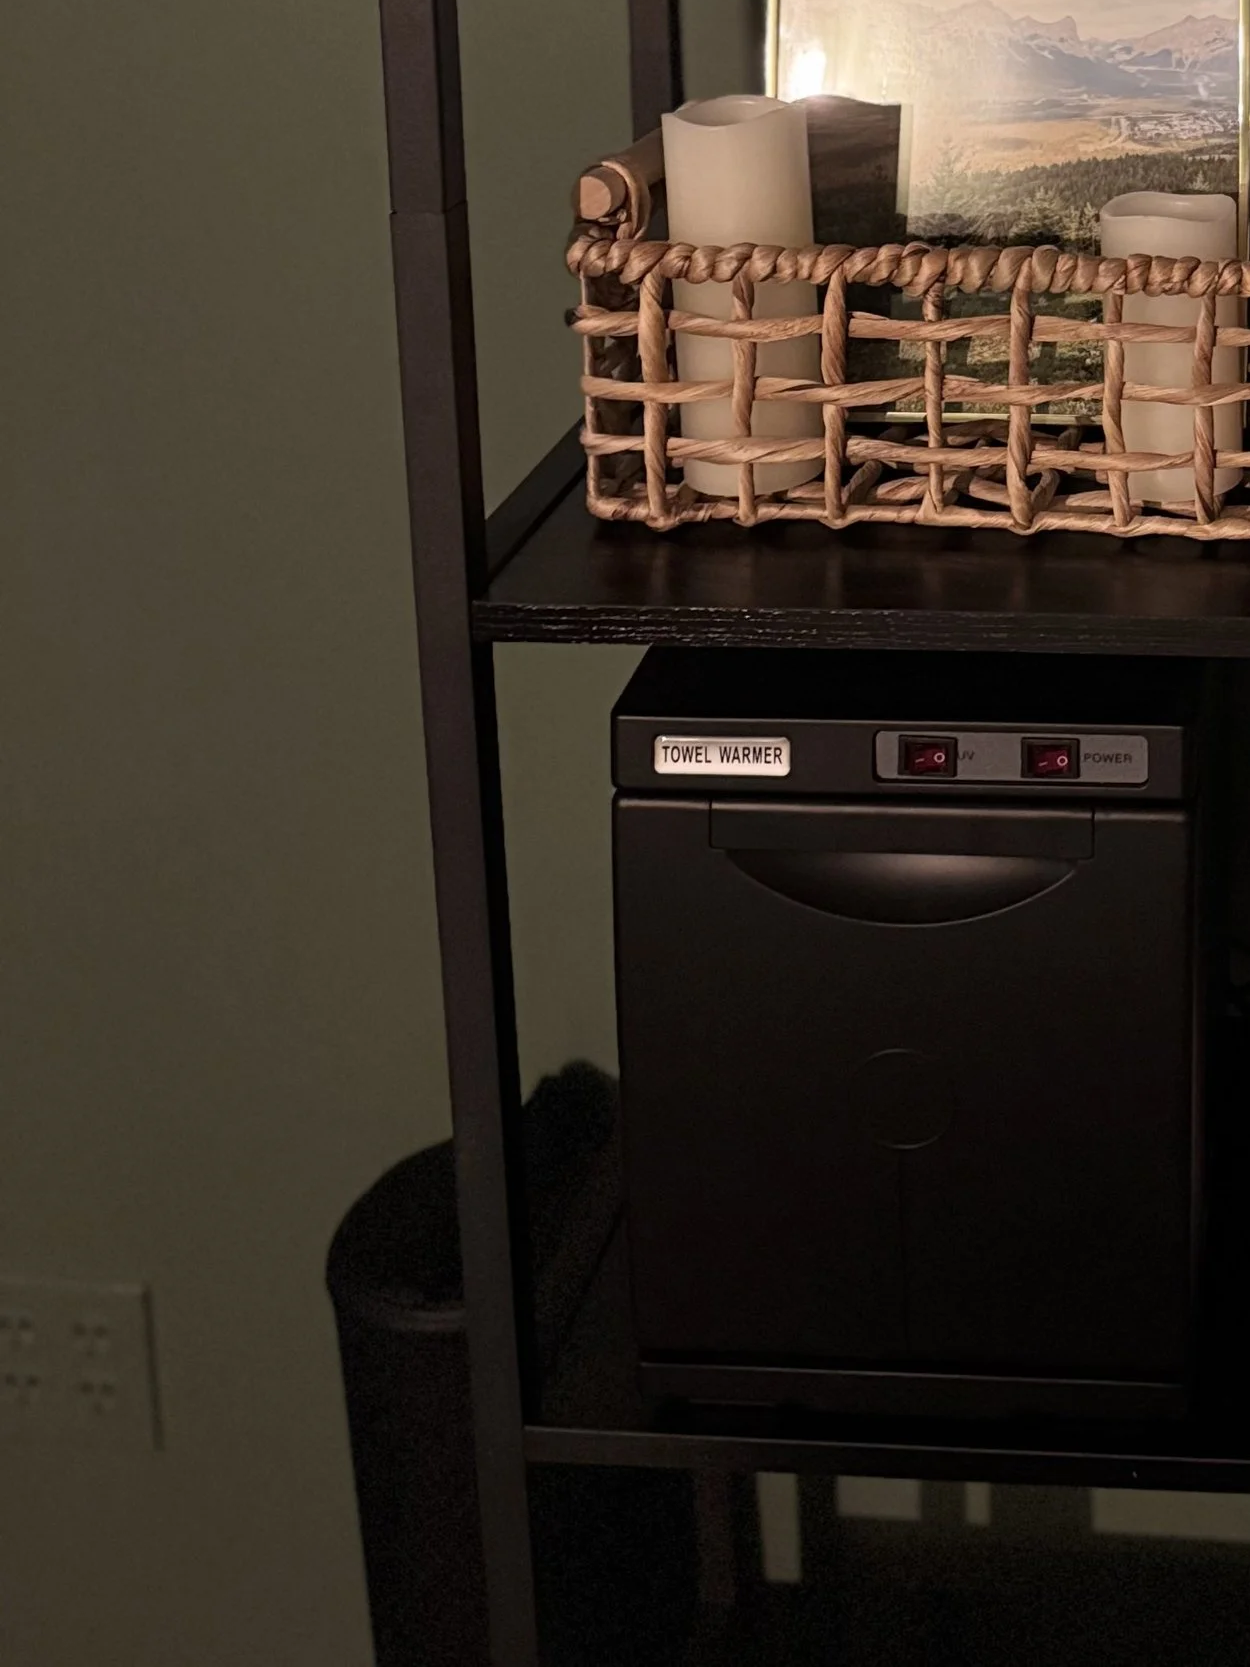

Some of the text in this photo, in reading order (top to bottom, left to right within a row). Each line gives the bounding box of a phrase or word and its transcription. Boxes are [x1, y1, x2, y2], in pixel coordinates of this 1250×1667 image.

[661, 745, 783, 765] TOWEL WARMER
[1082, 751, 1133, 764] POWER
